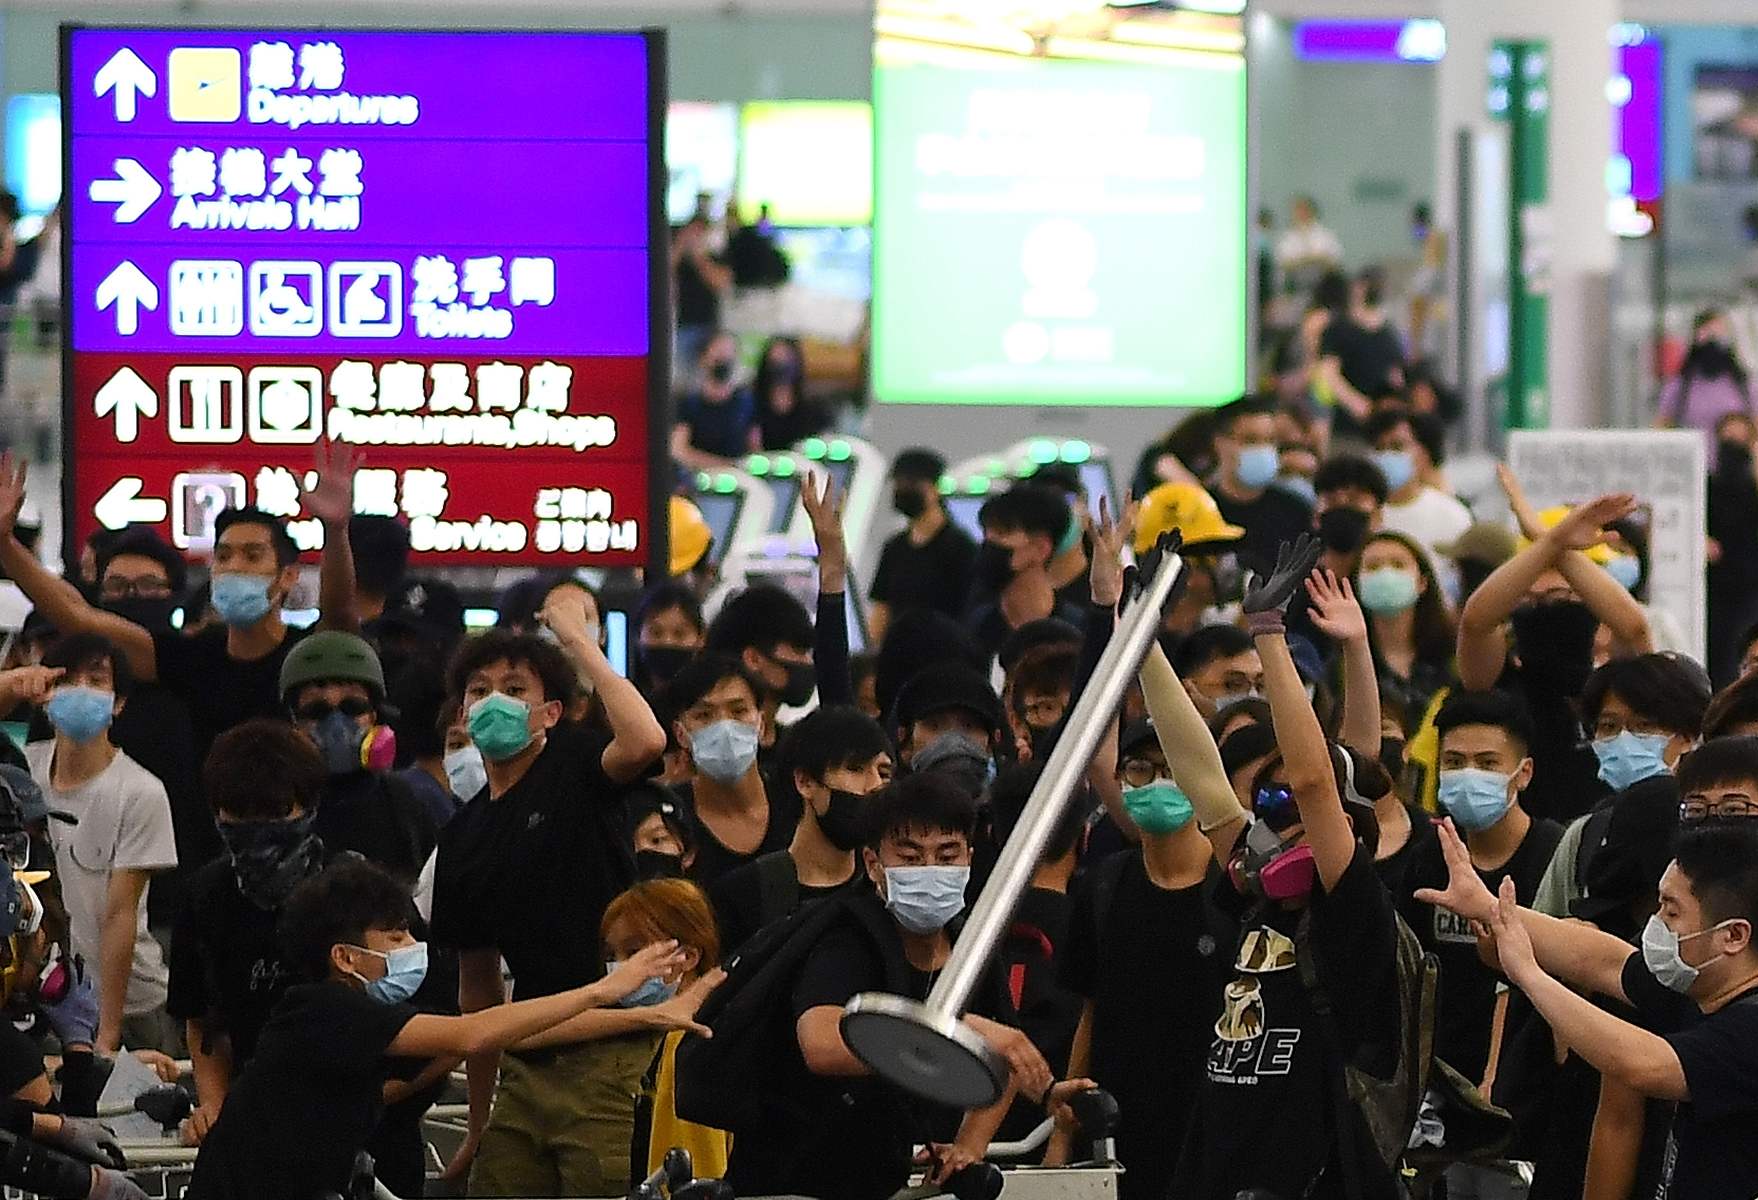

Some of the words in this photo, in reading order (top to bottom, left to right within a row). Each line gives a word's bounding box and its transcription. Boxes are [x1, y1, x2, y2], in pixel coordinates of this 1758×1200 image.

[249, 88, 419, 130] Departures
[171, 193, 293, 230] Arrivals
[297, 194, 361, 231] Hall
[410, 515, 528, 551] Service
